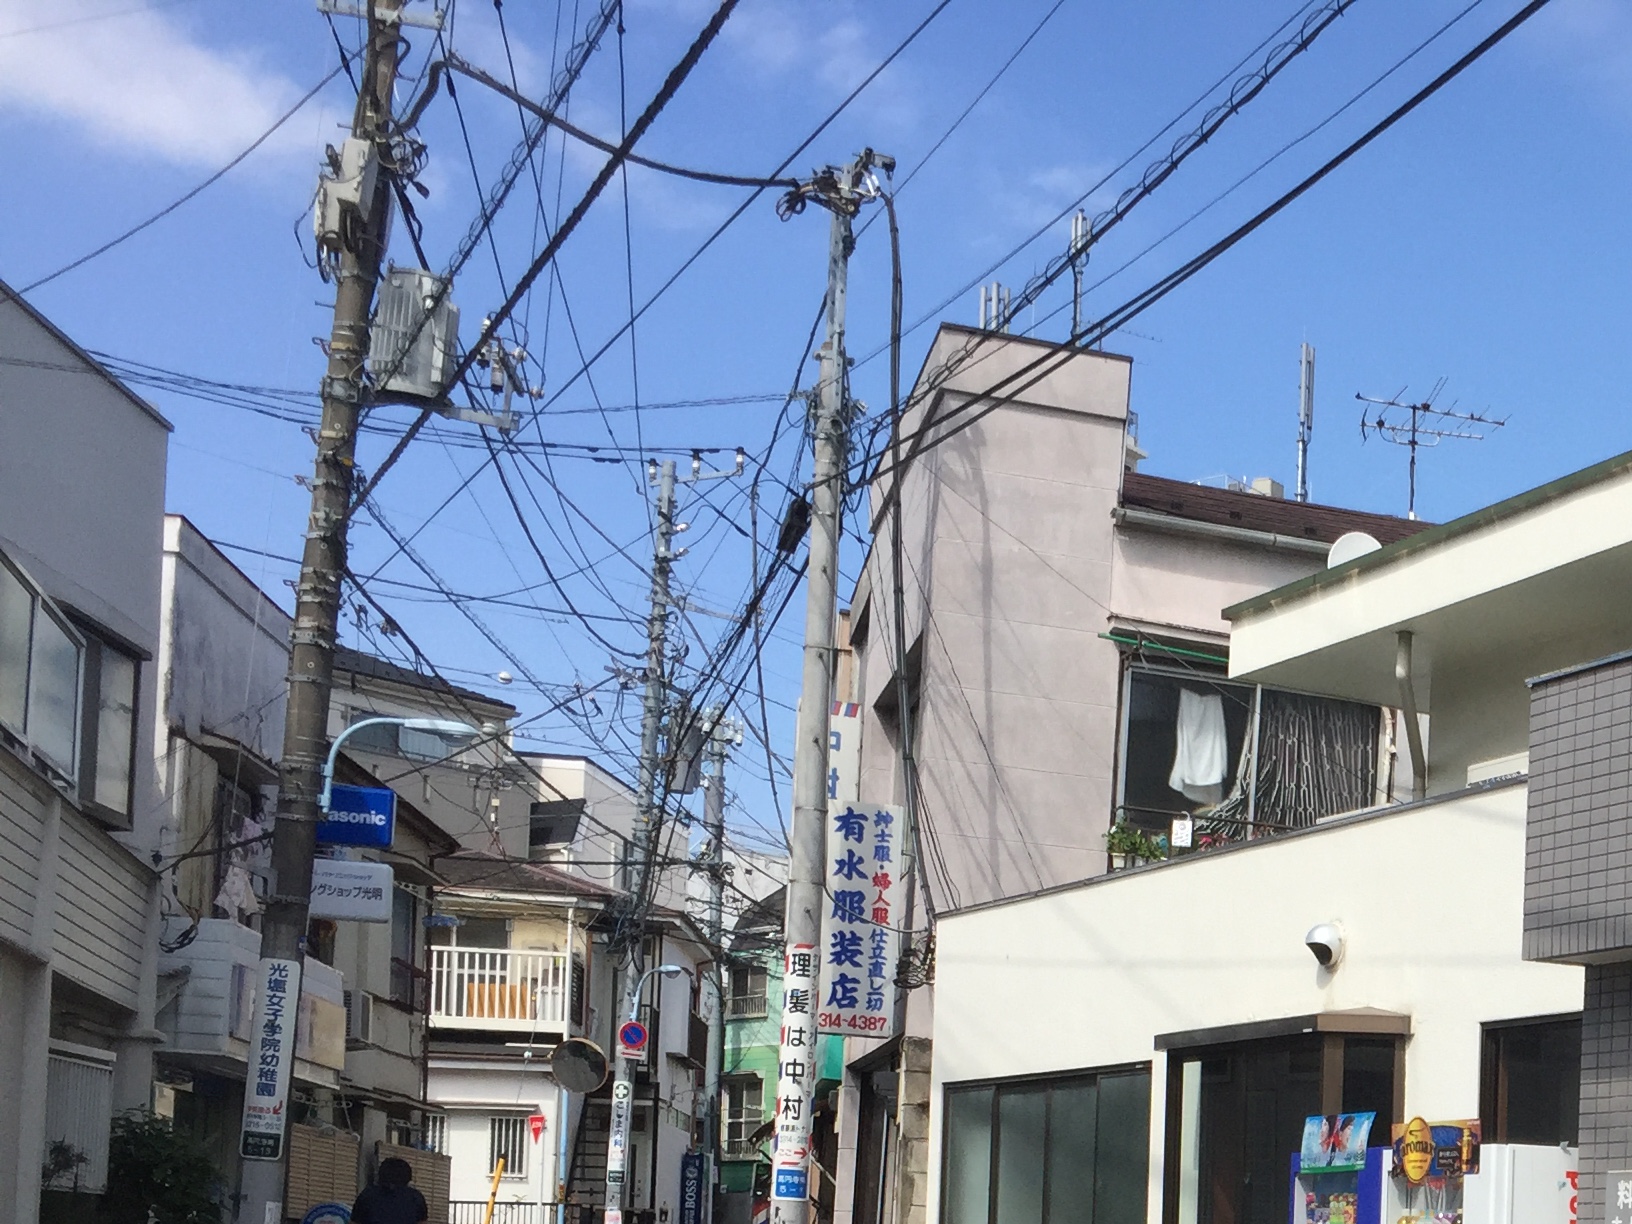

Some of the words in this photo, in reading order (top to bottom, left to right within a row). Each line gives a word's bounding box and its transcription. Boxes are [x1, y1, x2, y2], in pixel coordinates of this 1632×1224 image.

[328, 810, 386, 826] asonic
[826, 806, 869, 1010] 有水服装店
[255, 962, 289, 1098] 光塩女子学院幼稚園
[781, 952, 811, 1121] 理髪は中村
[685, 1180, 697, 1209] BOSS
